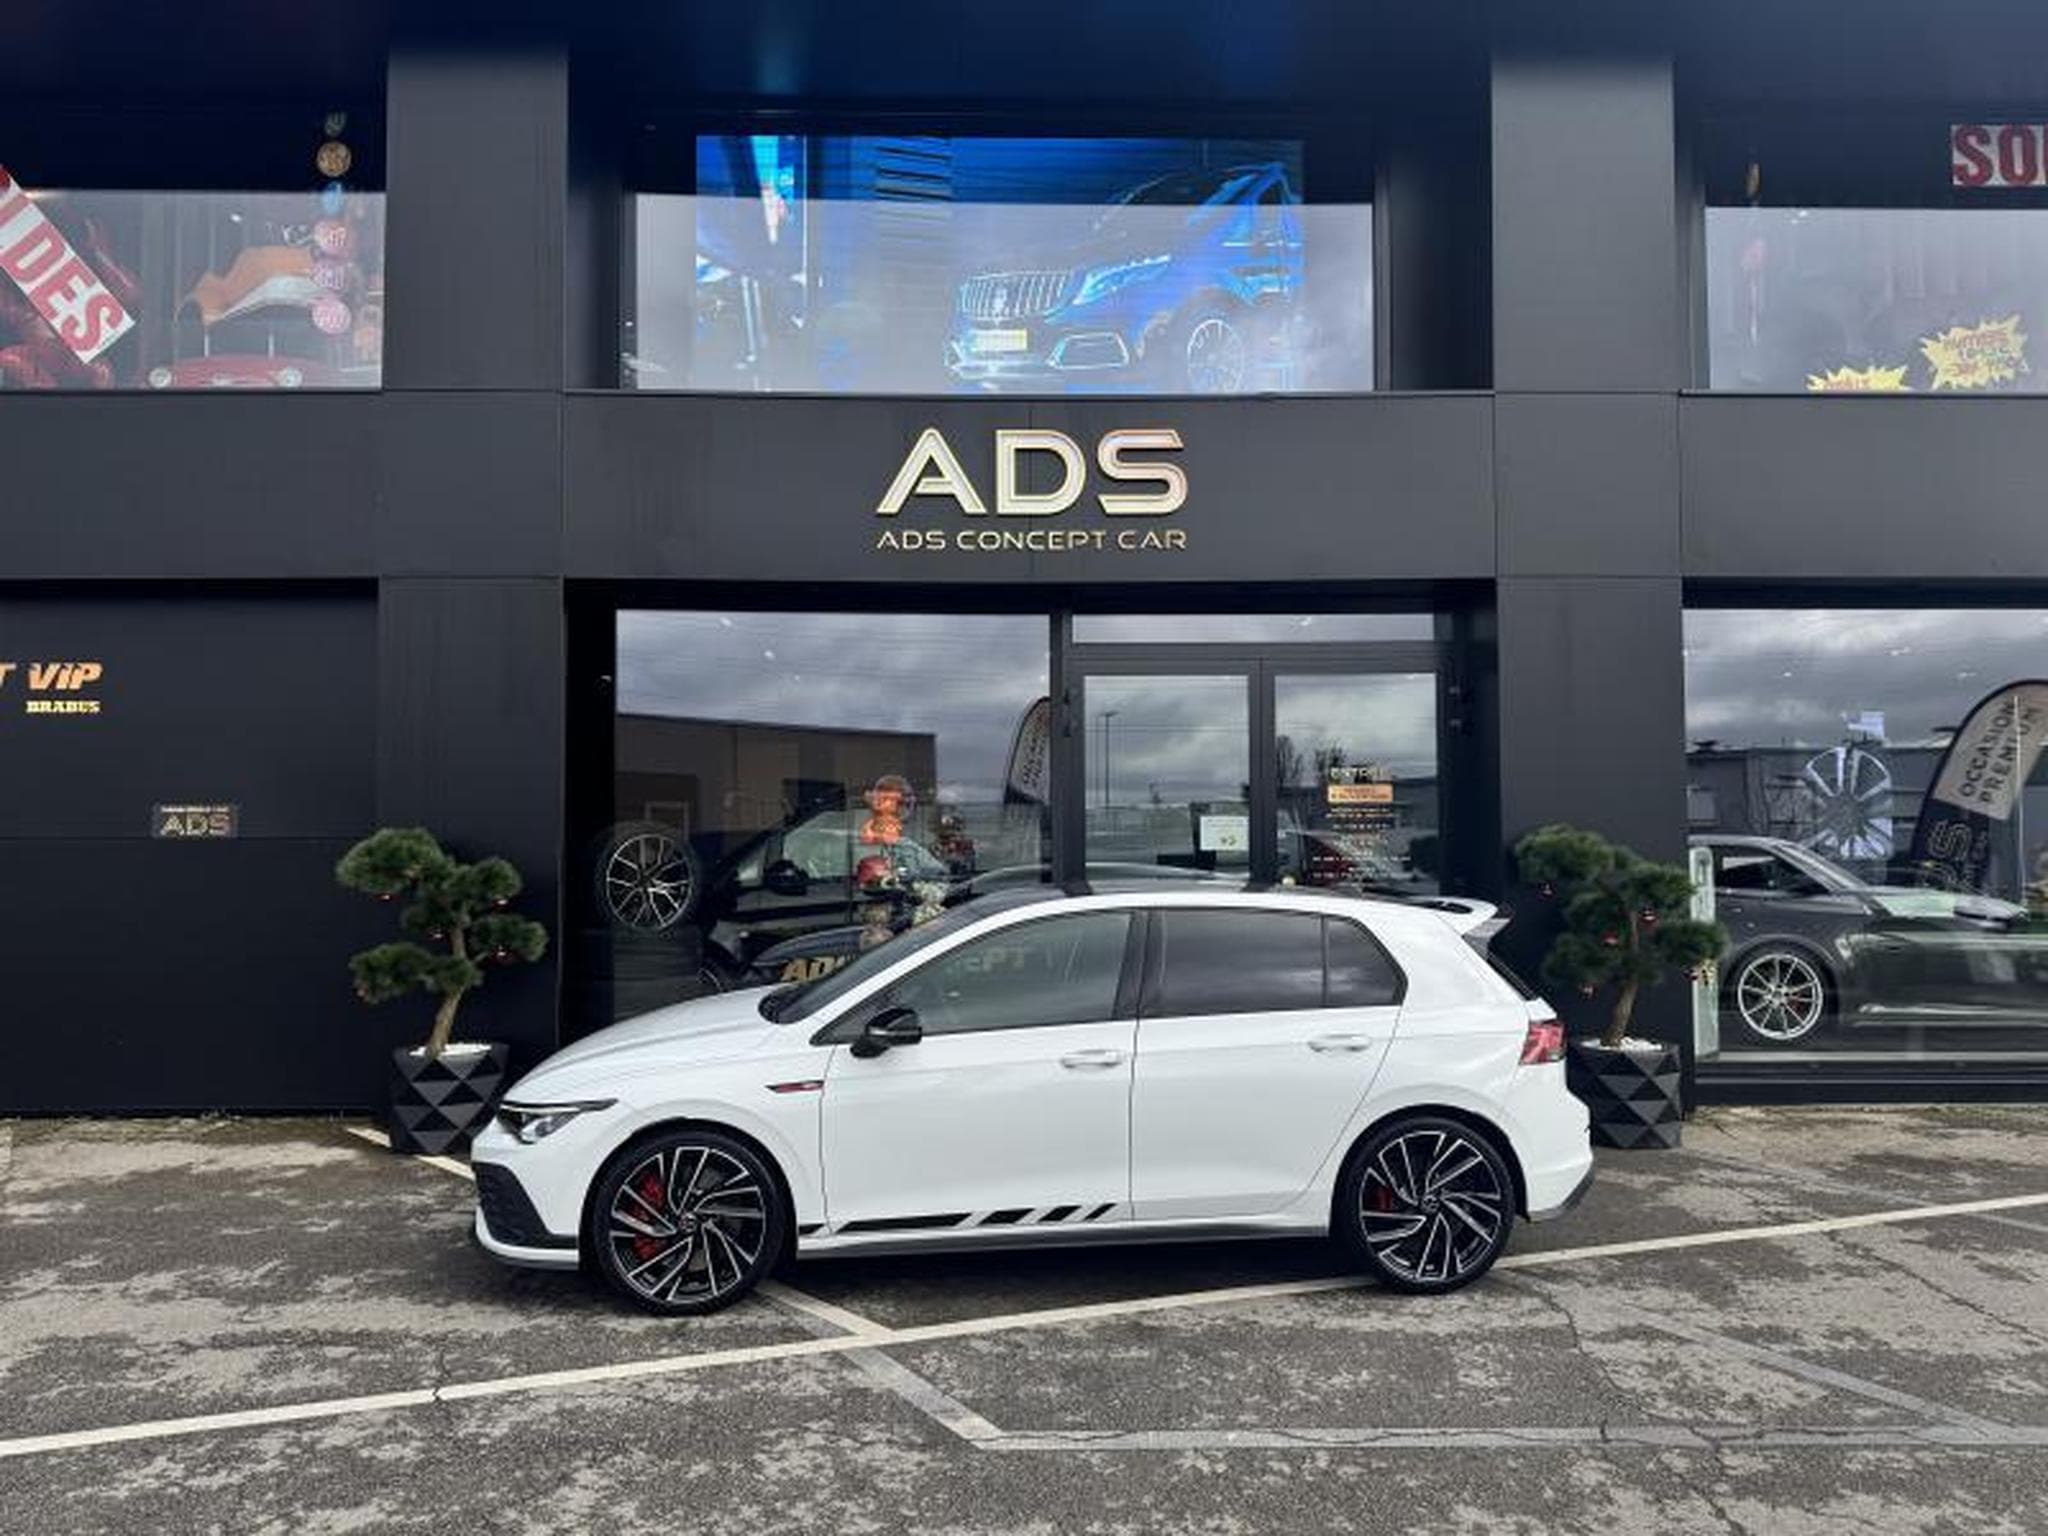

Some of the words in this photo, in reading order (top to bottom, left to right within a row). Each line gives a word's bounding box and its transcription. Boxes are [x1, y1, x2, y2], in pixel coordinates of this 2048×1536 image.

[1954, 125, 2048, 186] SO
[876, 427, 1188, 515] ADS
[877, 530, 947, 550] ADS
[956, 530, 1106, 550] CONCEPT
[1117, 530, 1187, 550] CAR
[26, 701, 100, 713] BRABUS
[1958, 701, 2015, 797] OCCASION
[1979, 707, 2039, 802] PREMIUM
[160, 814, 230, 836] ADS
